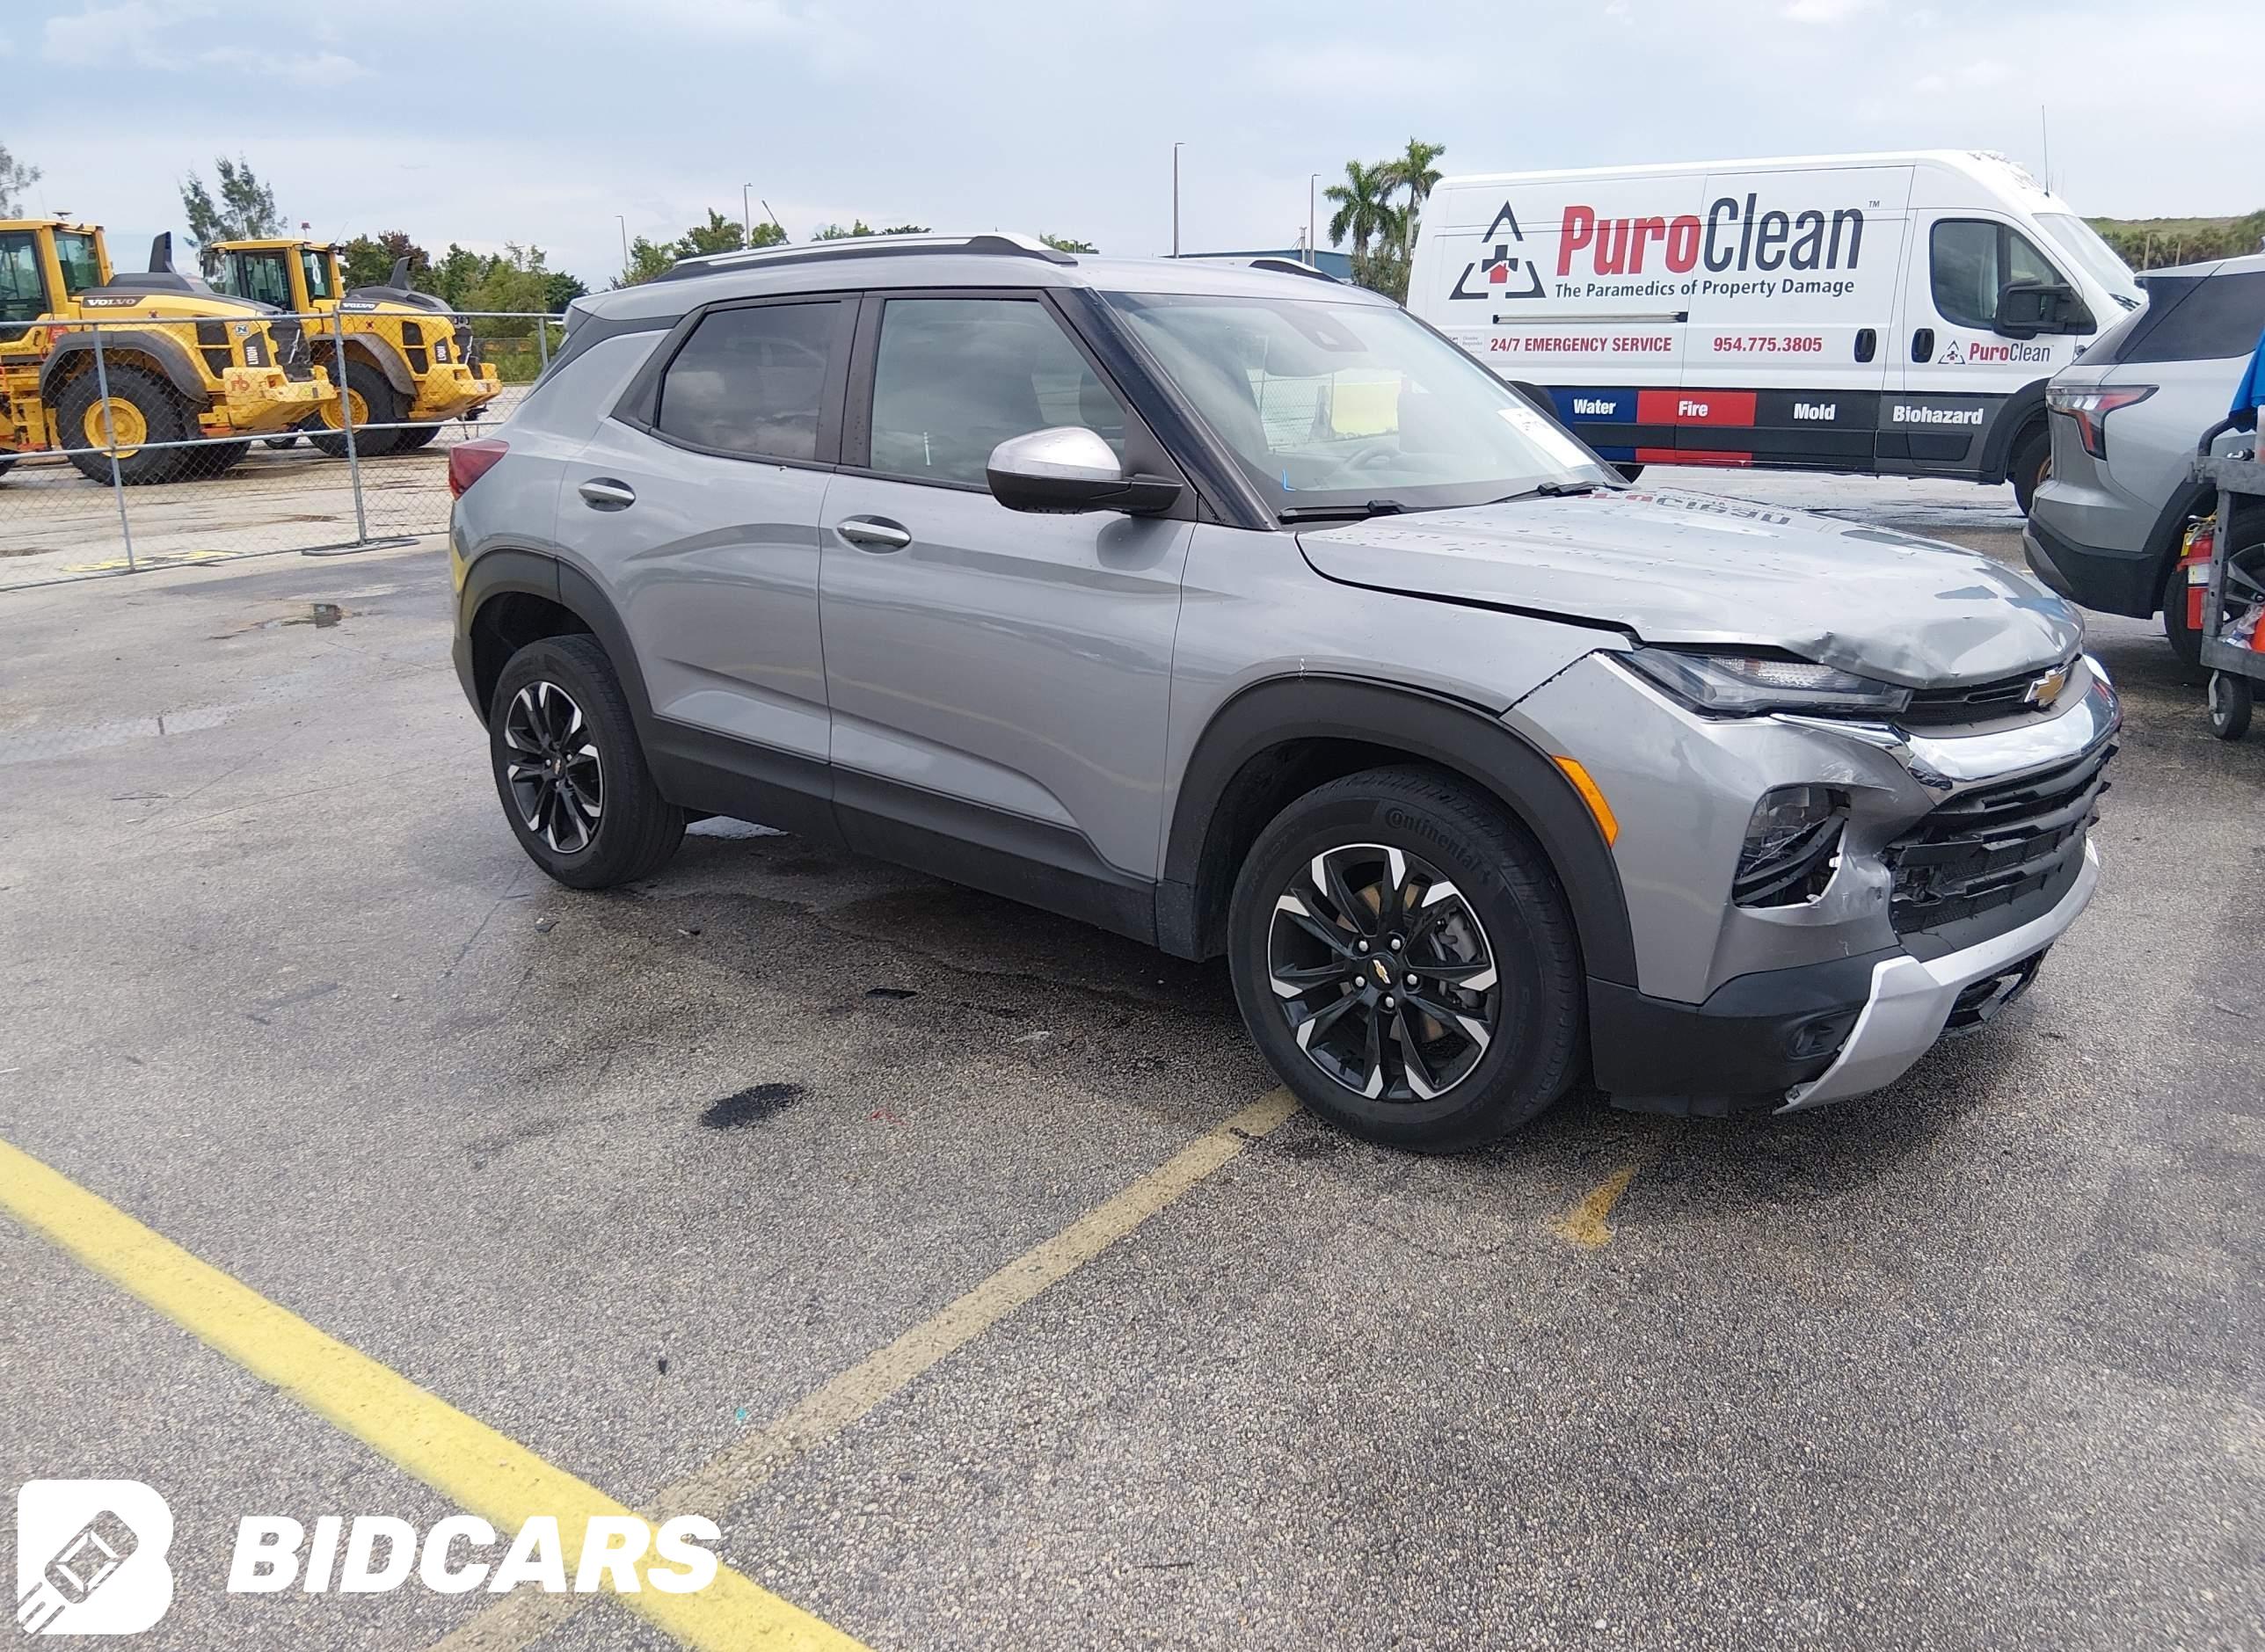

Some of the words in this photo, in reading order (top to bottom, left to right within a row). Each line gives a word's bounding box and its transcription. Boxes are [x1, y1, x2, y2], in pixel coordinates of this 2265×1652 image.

[1556, 193, 1864, 277] PuroClean
[310, 252, 322, 284] 8
[1555, 282, 1582, 298] The
[1586, 280, 1675, 298] Paramedics
[1680, 279, 1698, 295] of
[1702, 278, 1777, 299] Property
[1781, 278, 1855, 298] Damage
[1490, 337, 1521, 353] 24/7
[1525, 337, 1607, 353] EMERGENCY
[1612, 337, 1672, 353] SERVICE
[1713, 337, 1823, 353] 954.775.3805
[1969, 342, 2050, 362] PuroClean
[1573, 398, 1617, 414] Water
[1679, 400, 1708, 417] Fire
[1794, 403, 1836, 420] Mold
[1892, 405, 1984, 425] Biohazard
[1386, 808, 1480, 871] Continental
